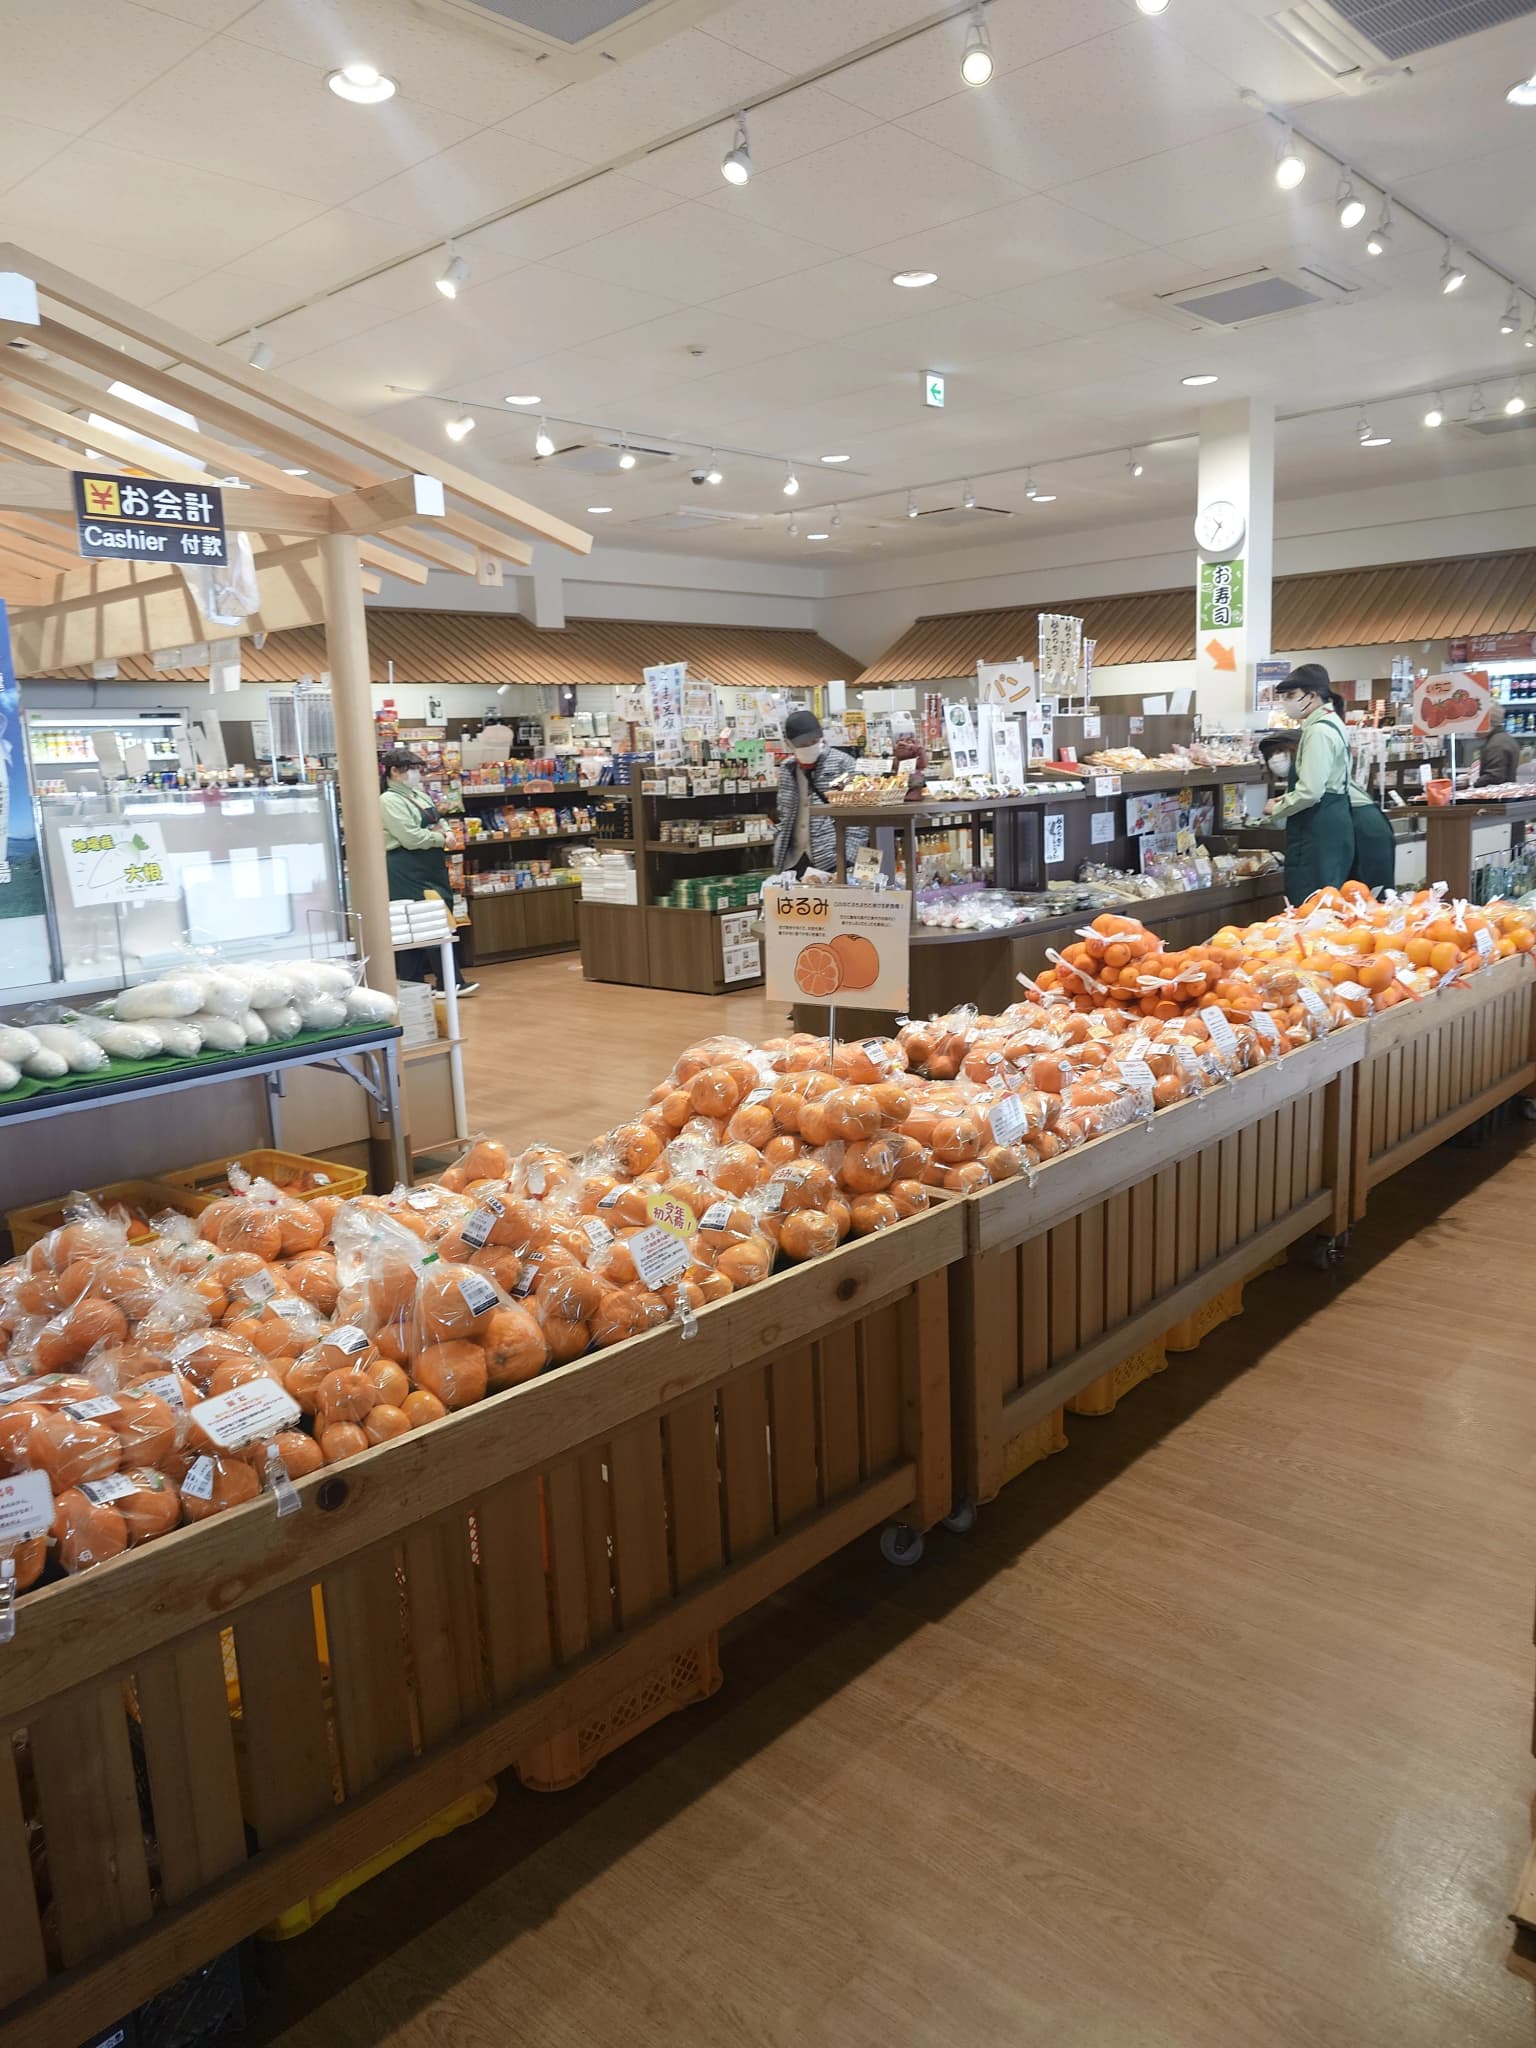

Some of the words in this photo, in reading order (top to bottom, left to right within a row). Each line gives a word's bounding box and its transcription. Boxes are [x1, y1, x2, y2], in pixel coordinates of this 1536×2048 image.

[120, 484, 214, 523] お会計
[84, 525, 169, 552] Cashier
[180, 533, 223, 557] 付款
[1214, 566, 1230, 624] お寿司
[123, 862, 163, 884] 大根
[777, 896, 829, 916] はるみ
[665, 1201, 686, 1217] 今年
